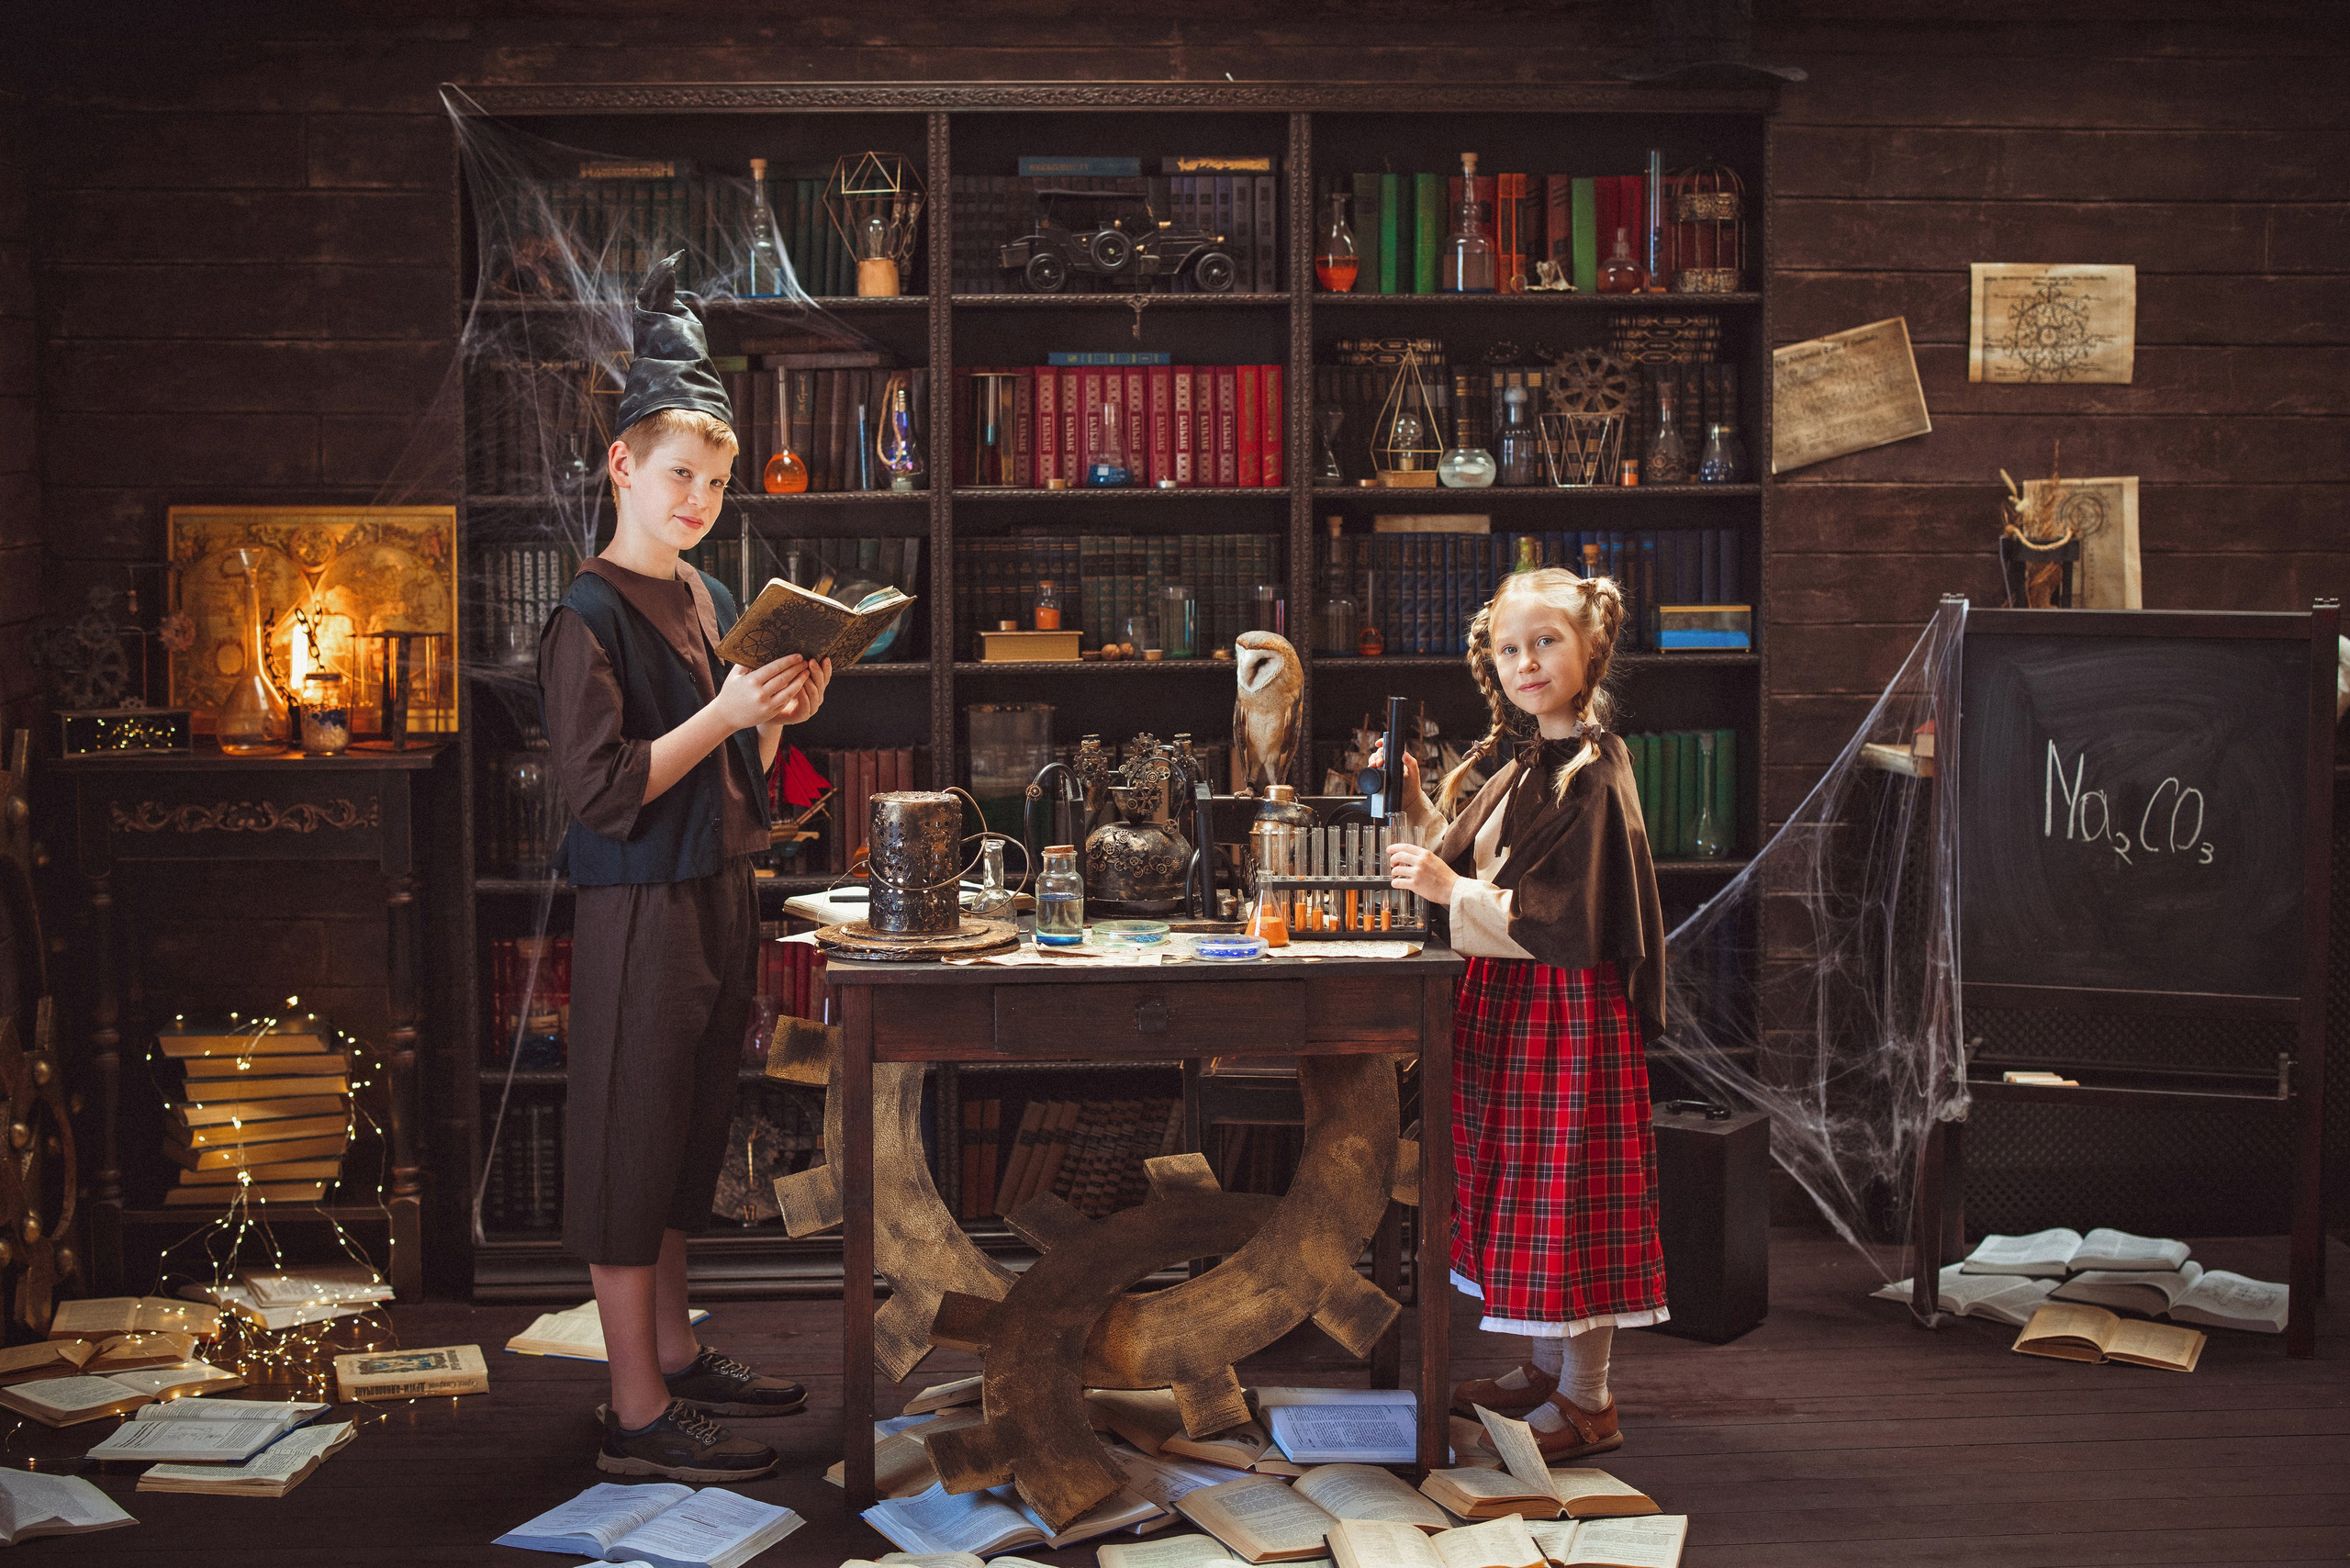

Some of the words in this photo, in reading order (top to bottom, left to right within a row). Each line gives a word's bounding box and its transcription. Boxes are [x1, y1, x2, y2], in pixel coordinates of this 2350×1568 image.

[1066, 416, 1075, 452] БАЛЬЗАК
[1131, 416, 1140, 450] БАЛЬЗАК
[1179, 415, 1189, 450] БАЛЬЗАК
[1200, 415, 1210, 450] БАЛЬЗАК
[1223, 415, 1232, 450] БАЛЬЗАК
